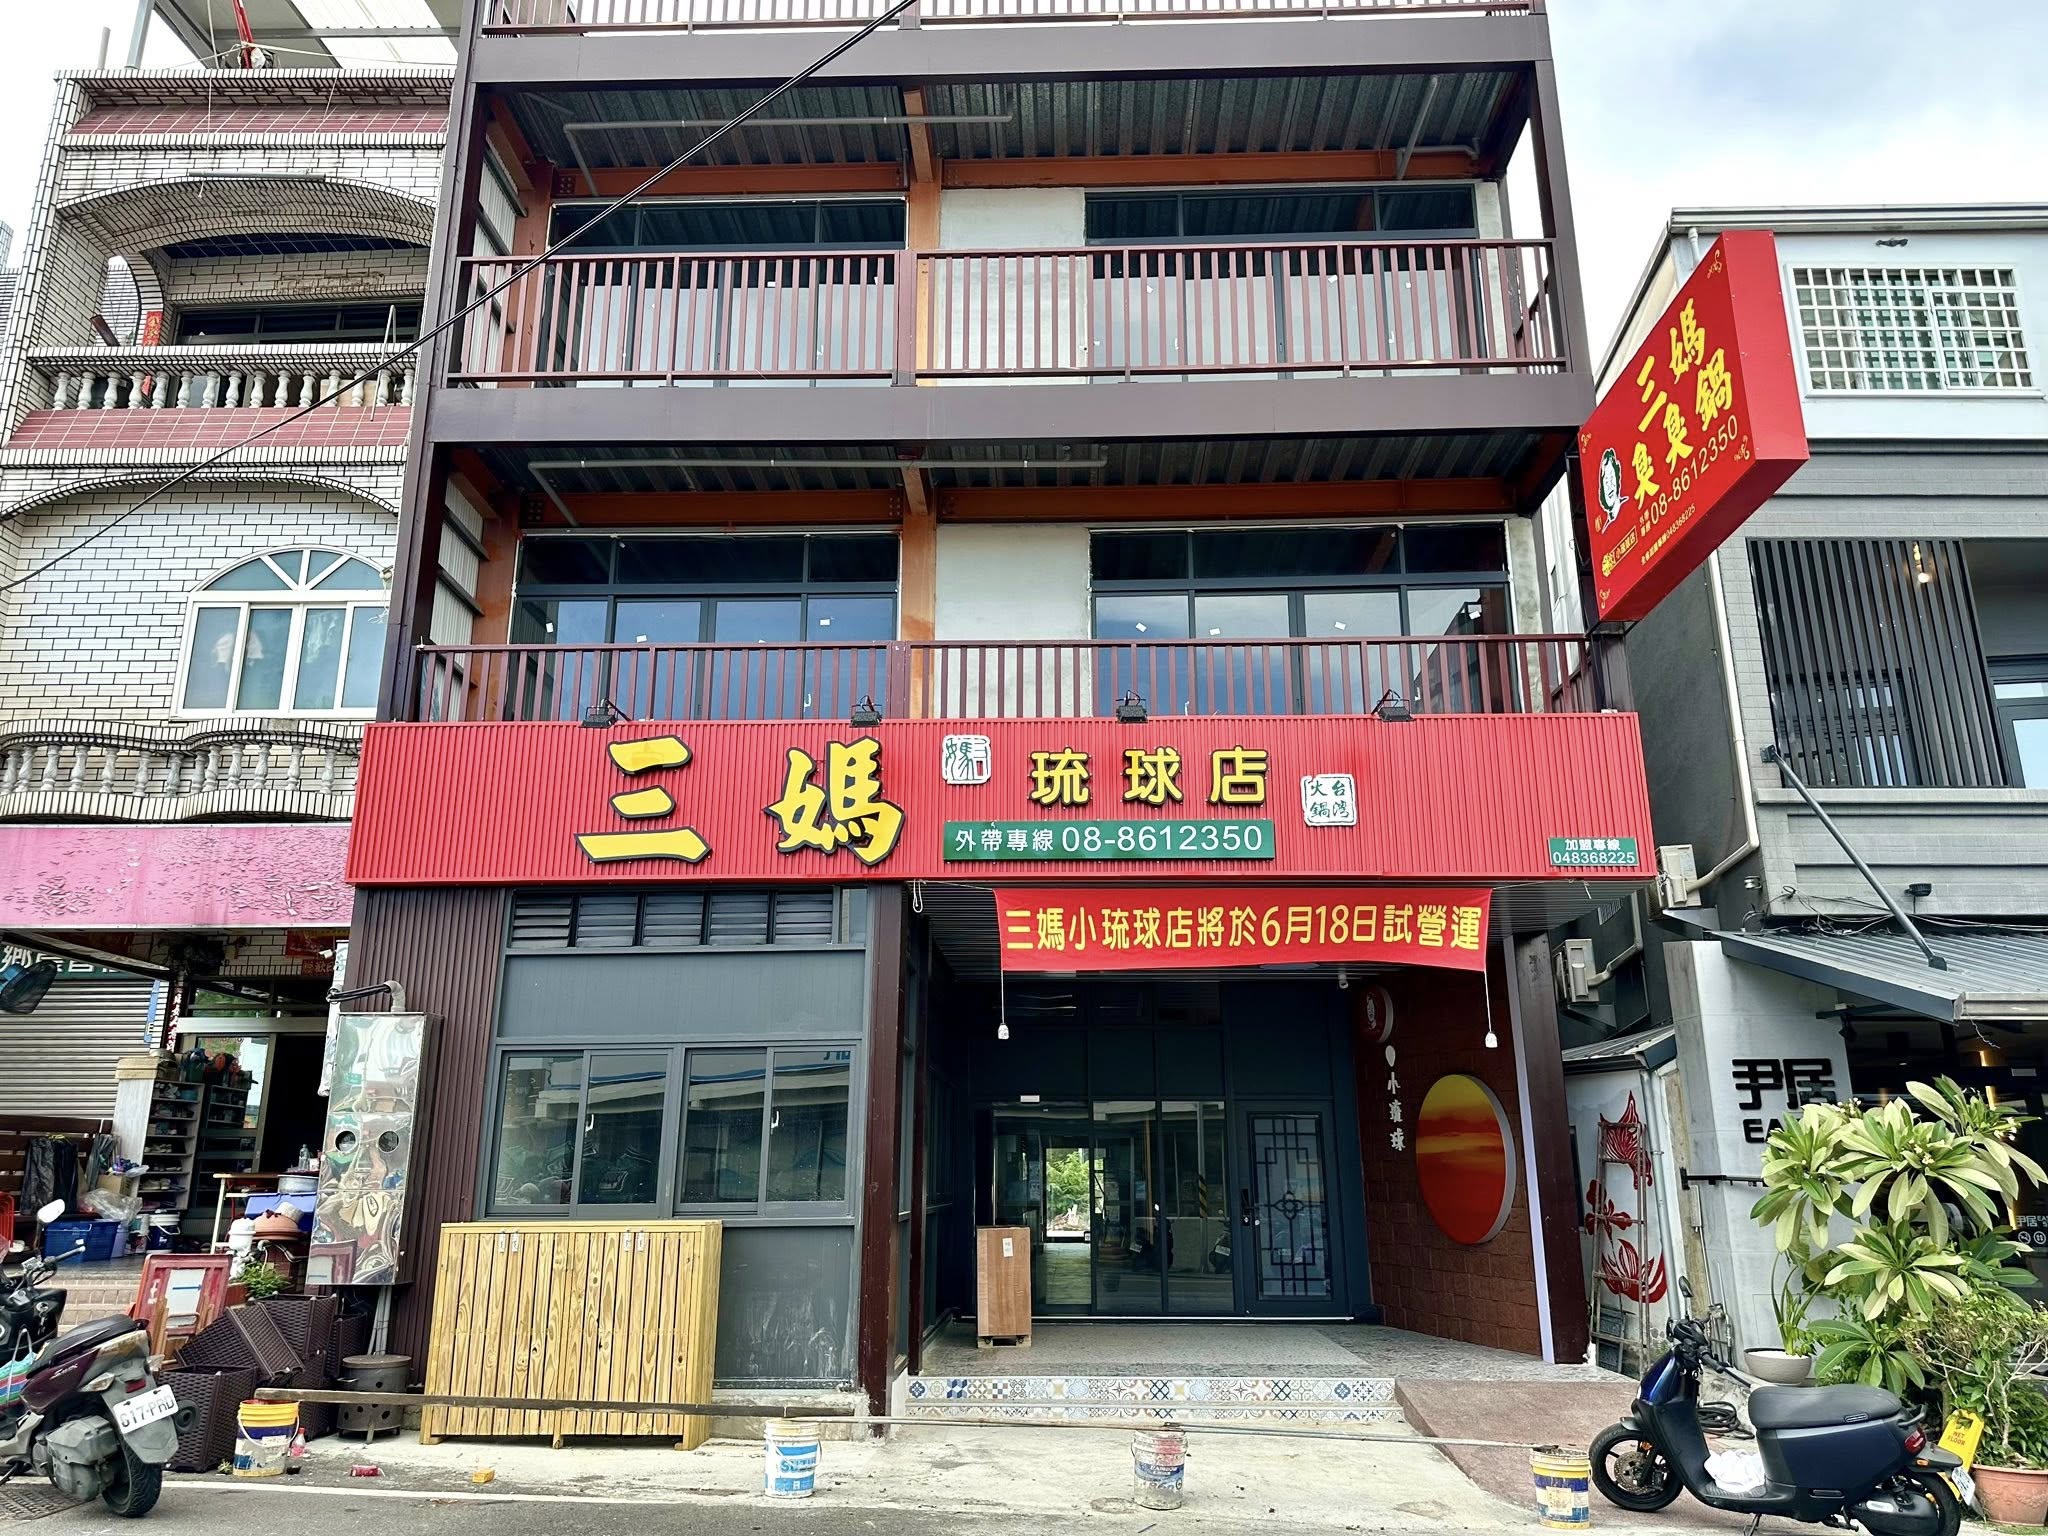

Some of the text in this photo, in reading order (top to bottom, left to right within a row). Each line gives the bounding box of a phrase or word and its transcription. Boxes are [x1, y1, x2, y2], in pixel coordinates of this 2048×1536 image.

[1636, 297, 1706, 433] 三媽
[1631, 347, 1733, 510] 臭臭鍋
[1649, 414, 1739, 526] 08-8612350
[573, 734, 1270, 866] 三媽 琉球店
[954, 825, 1263, 853] 外帶專線 08-8612350
[1552, 851, 1635, 864] 048368225
[1564, 838, 1621, 851] 加盟專線
[1004, 903, 1484, 952] 三媽小琉球店將於6月18日試營運
